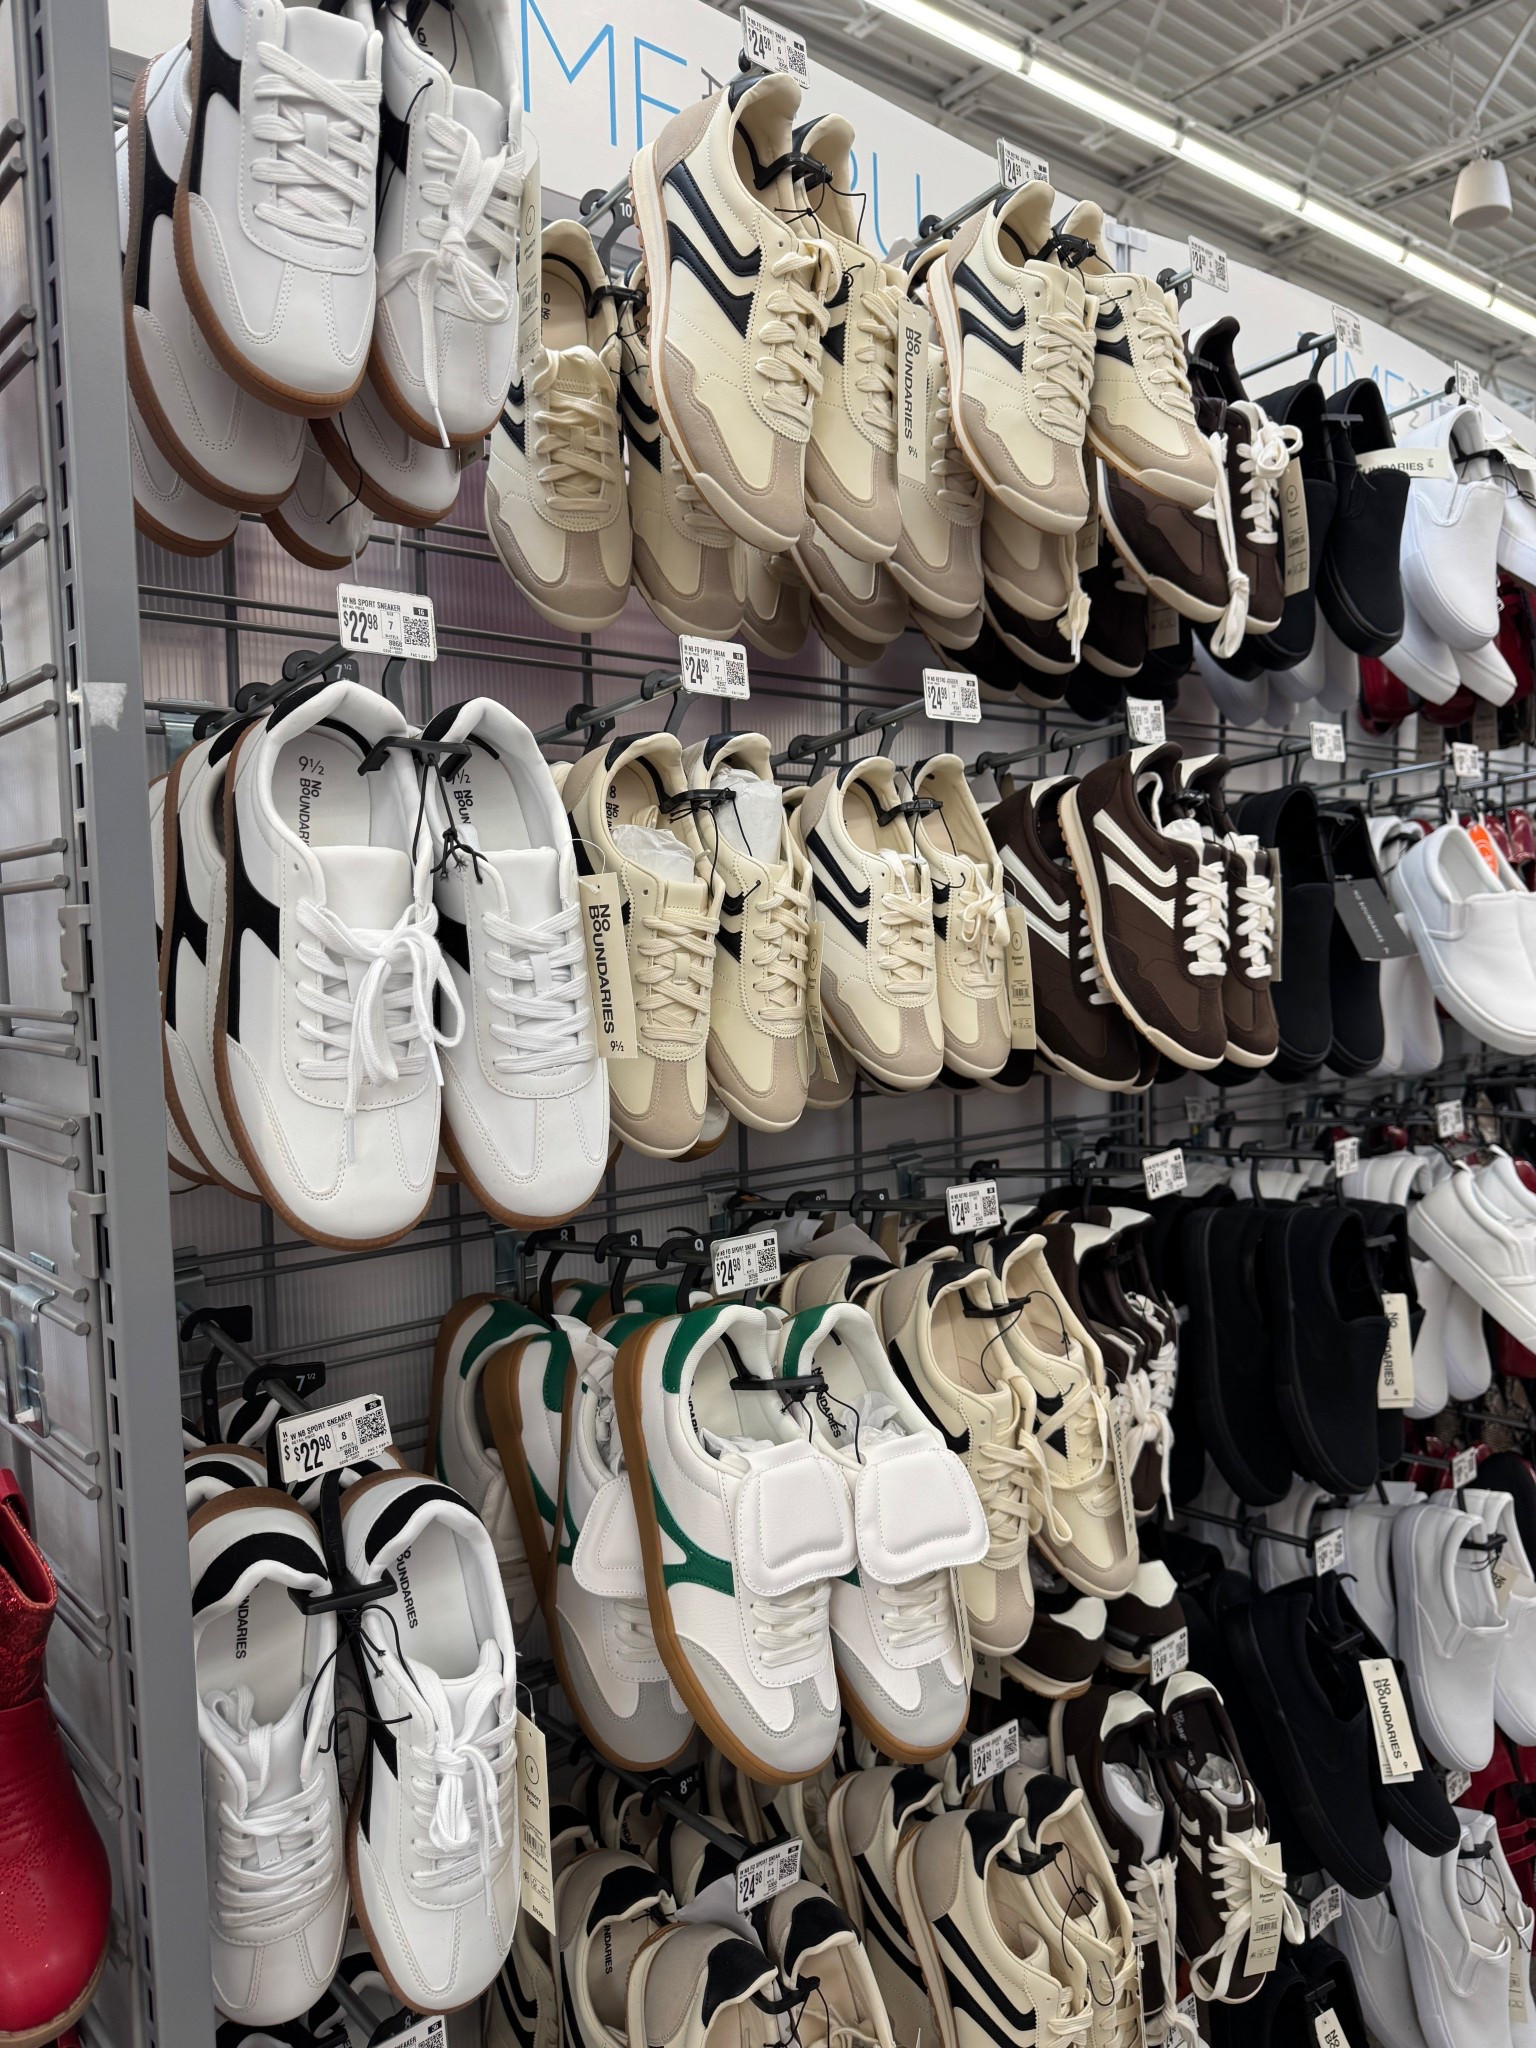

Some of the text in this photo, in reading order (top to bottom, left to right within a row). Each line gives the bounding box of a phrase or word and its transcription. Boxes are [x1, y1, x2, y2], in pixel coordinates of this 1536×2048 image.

[520, 0, 687, 151] ME
[620, 202, 633, 218] 10
[1182, 282, 1188, 294] 9
[543, 293, 550, 304] 0
[912, 330, 922, 355] NO
[904, 326, 914, 440] BOUNDARIES
[342, 596, 348, 604] W
[358, 598, 376, 608] SPORT
[377, 602, 401, 612] SNEAKER
[343, 610, 378, 644] $2298
[388, 621, 394, 630] 7
[334, 664, 342, 680] 7
[684, 656, 710, 684] $2498
[716, 664, 720, 672] 7
[311, 779, 322, 798] NO
[610, 785, 616, 798] 8
[463, 789, 474, 808] NO
[612, 804, 620, 818] NO
[599, 904, 610, 932] NO
[588, 904, 614, 1034] BOUNDARIES
[716, 1258, 741, 1287] $2498
[1390, 1312, 1398, 1328] NO
[1384, 1341, 1394, 1386] DARIES
[296, 1375, 306, 1392] 7
[290, 1411, 352, 1441] W NB SPORT SNEAKER
[342, 1431, 347, 1440] 8
[294, 1434, 332, 1473] $2298
[403, 1545, 412, 1560] O
[396, 1554, 419, 1629] OUNDARIES
[236, 1596, 250, 1660] NDARIES
[1380, 1678, 1392, 1696] NO
[1372, 1680, 1402, 1759] BOUNDARIES
[524, 1784, 542, 1806] Memory
[680, 1780, 688, 1794] 8
[526, 1794, 538, 1810] Foam
[740, 1870, 762, 1902] $2498
[604, 1925, 612, 1975] NDARIES
[1330, 2029, 1340, 2048] NO
